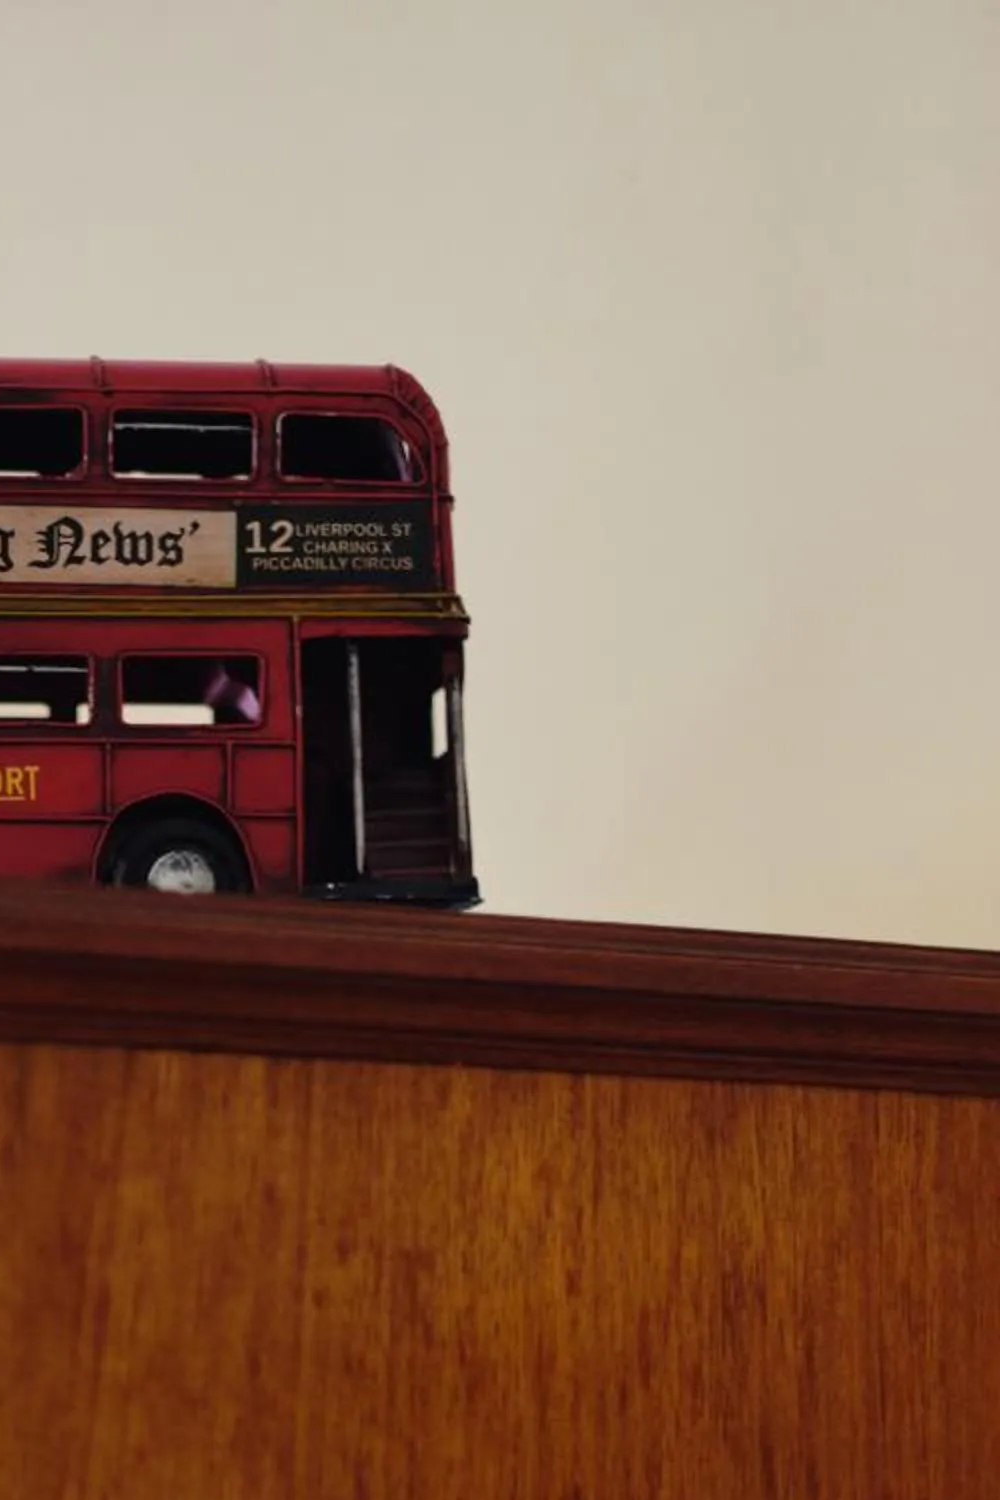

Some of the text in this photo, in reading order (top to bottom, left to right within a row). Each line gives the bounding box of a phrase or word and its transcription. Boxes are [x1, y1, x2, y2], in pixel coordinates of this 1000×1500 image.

[244, 519, 295, 554] 12
[295, 522, 413, 538] LIVERPOOL ST
[302, 540, 393, 554] CHARING X
[252, 556, 414, 571] PICCADILLY CIRCUS
